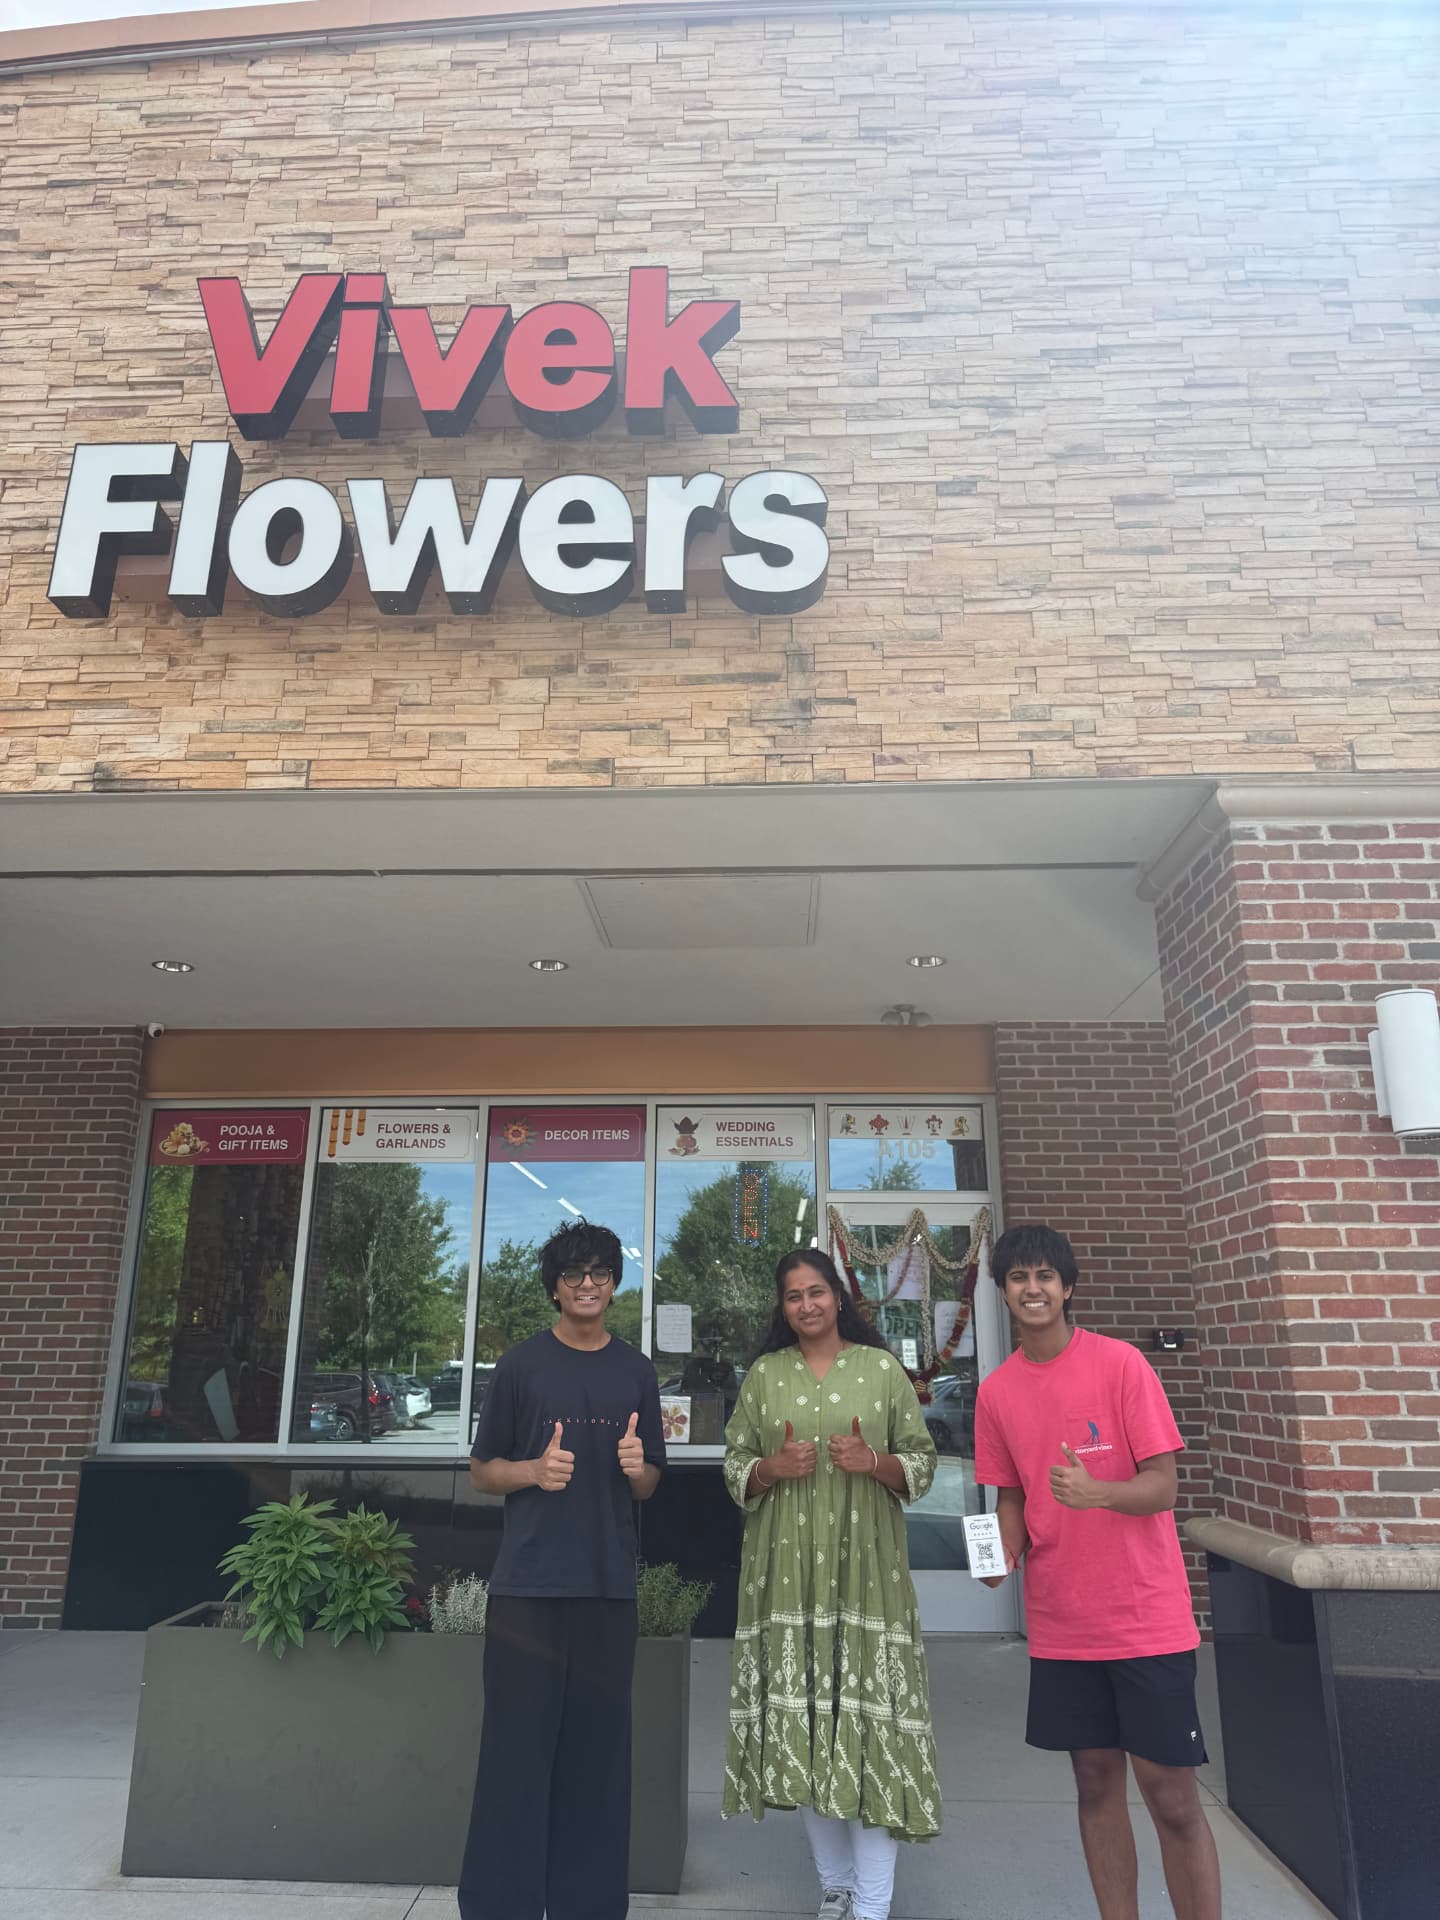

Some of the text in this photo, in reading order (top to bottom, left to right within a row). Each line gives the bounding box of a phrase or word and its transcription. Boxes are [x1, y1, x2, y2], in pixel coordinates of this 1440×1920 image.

[197, 265, 741, 418] Vivek
[46, 440, 830, 602] Flowers
[220, 1124, 276, 1136] POOJA &
[377, 1123, 451, 1134] FLOWERS &
[715, 1121, 776, 1132] WEDDING
[544, 1129, 630, 1141] DECOR ITEMS
[218, 1139, 289, 1151] GIFT ITEMS
[376, 1138, 446, 1149] GARLANDS
[715, 1136, 794, 1147] ESSENTIALS
[877, 1139, 936, 1159] A105
[743, 1172, 759, 1239] OPEN
